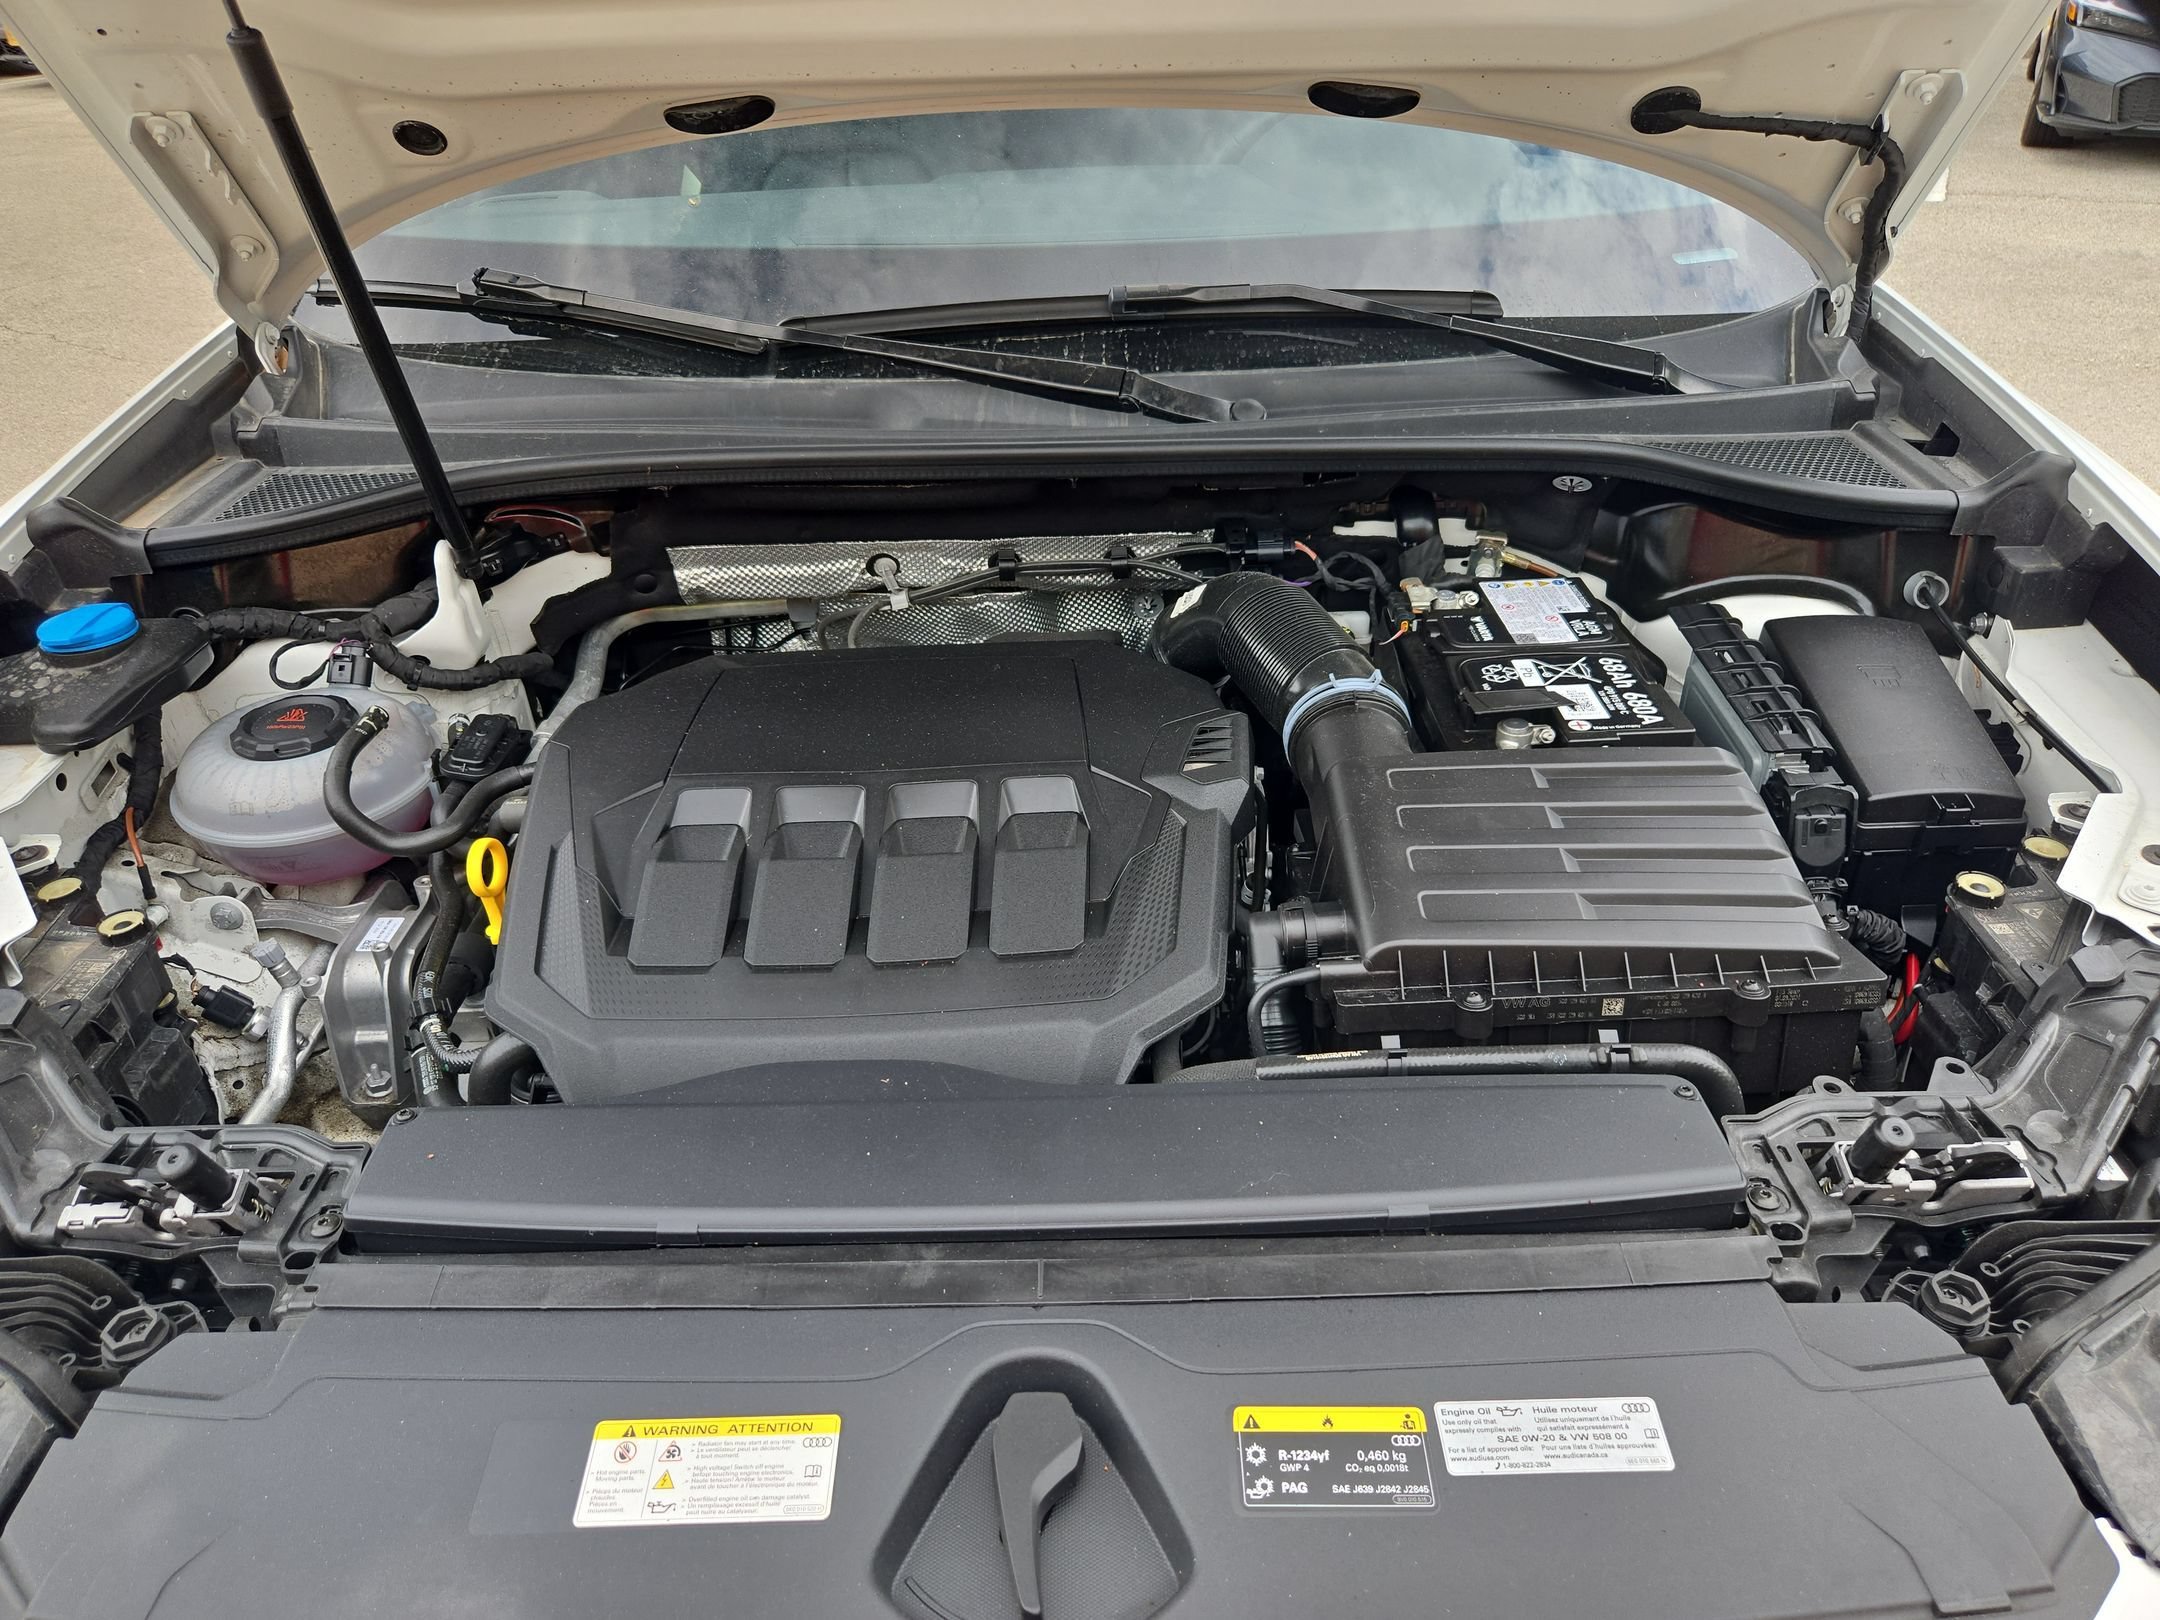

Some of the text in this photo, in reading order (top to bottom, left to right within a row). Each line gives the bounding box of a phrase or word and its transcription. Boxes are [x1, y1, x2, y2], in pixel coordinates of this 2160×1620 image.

[1519, 667, 1532, 678] Pb
[1598, 657, 1637, 689] 68Ah
[1622, 691, 1664, 726] 680A
[1501, 998, 1525, 1009] VW
[1528, 997, 1550, 1008] AG
[1440, 1407, 1491, 1417] Engine Oil
[1532, 1406, 1558, 1414] Huile
[643, 1422, 814, 1436] WARNING ATTENTION
[1497, 1435, 1520, 1443] SAE
[1521, 1434, 1556, 1442] 0W-20
[1569, 1433, 1589, 1441] VW
[1592, 1432, 1613, 1440] 508
[1614, 1432, 1628, 1440] 00
[735, 1440, 747, 1448] may
[1616, 1442, 1658, 1450] approuvées:
[1278, 1449, 1407, 1464] R-1234yf 0,460 kg
[1450, 1454, 1510, 1462] www.audiusa.com
[1279, 1463, 1302, 1472] GWP
[1303, 1463, 1310, 1472] 4
[1364, 1465, 1376, 1474] eq
[1376, 1463, 1409, 1473] 0,0018t
[1503, 1461, 1552, 1469] 1-800-822-2834
[1281, 1482, 1430, 1494] PAG SAE J639 J2842 J2845
